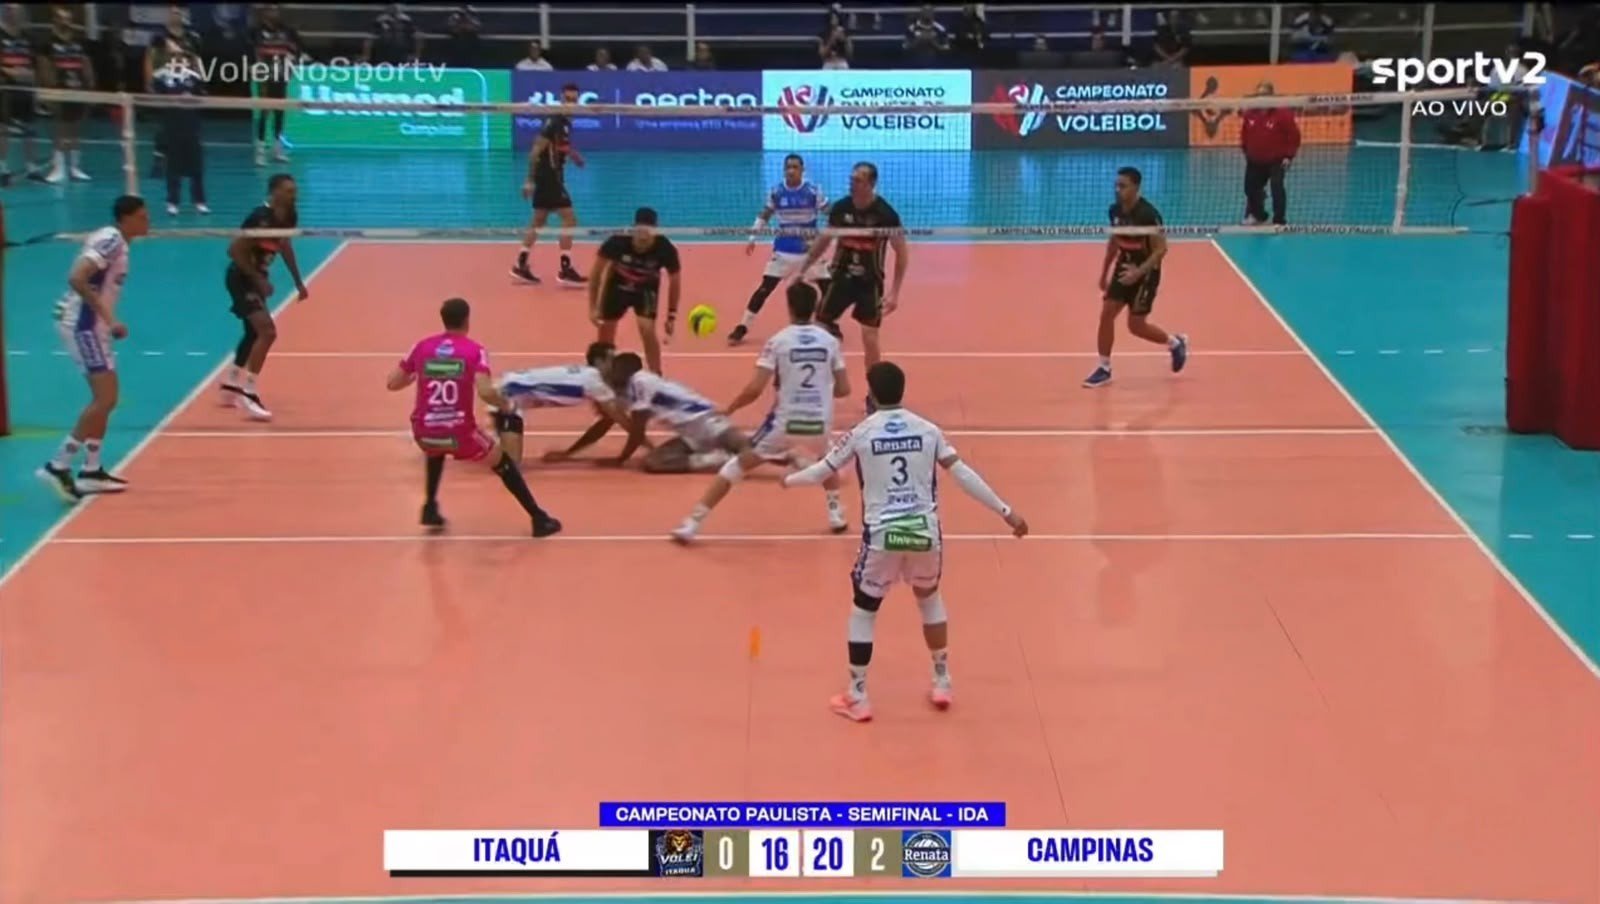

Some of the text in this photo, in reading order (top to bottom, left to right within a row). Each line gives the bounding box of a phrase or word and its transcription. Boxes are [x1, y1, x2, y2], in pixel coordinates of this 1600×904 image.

[840, 86, 946, 99] CAMPEONATO
[1055, 83, 1168, 98] CAMPEONATO
[840, 115, 946, 130] VOLEIBOL
[1055, 113, 1167, 132] VOLEIBOL
[801, 363, 816, 389] 2
[428, 379, 459, 405] 20
[873, 438, 922, 453] Renata
[890, 455, 909, 486] 3
